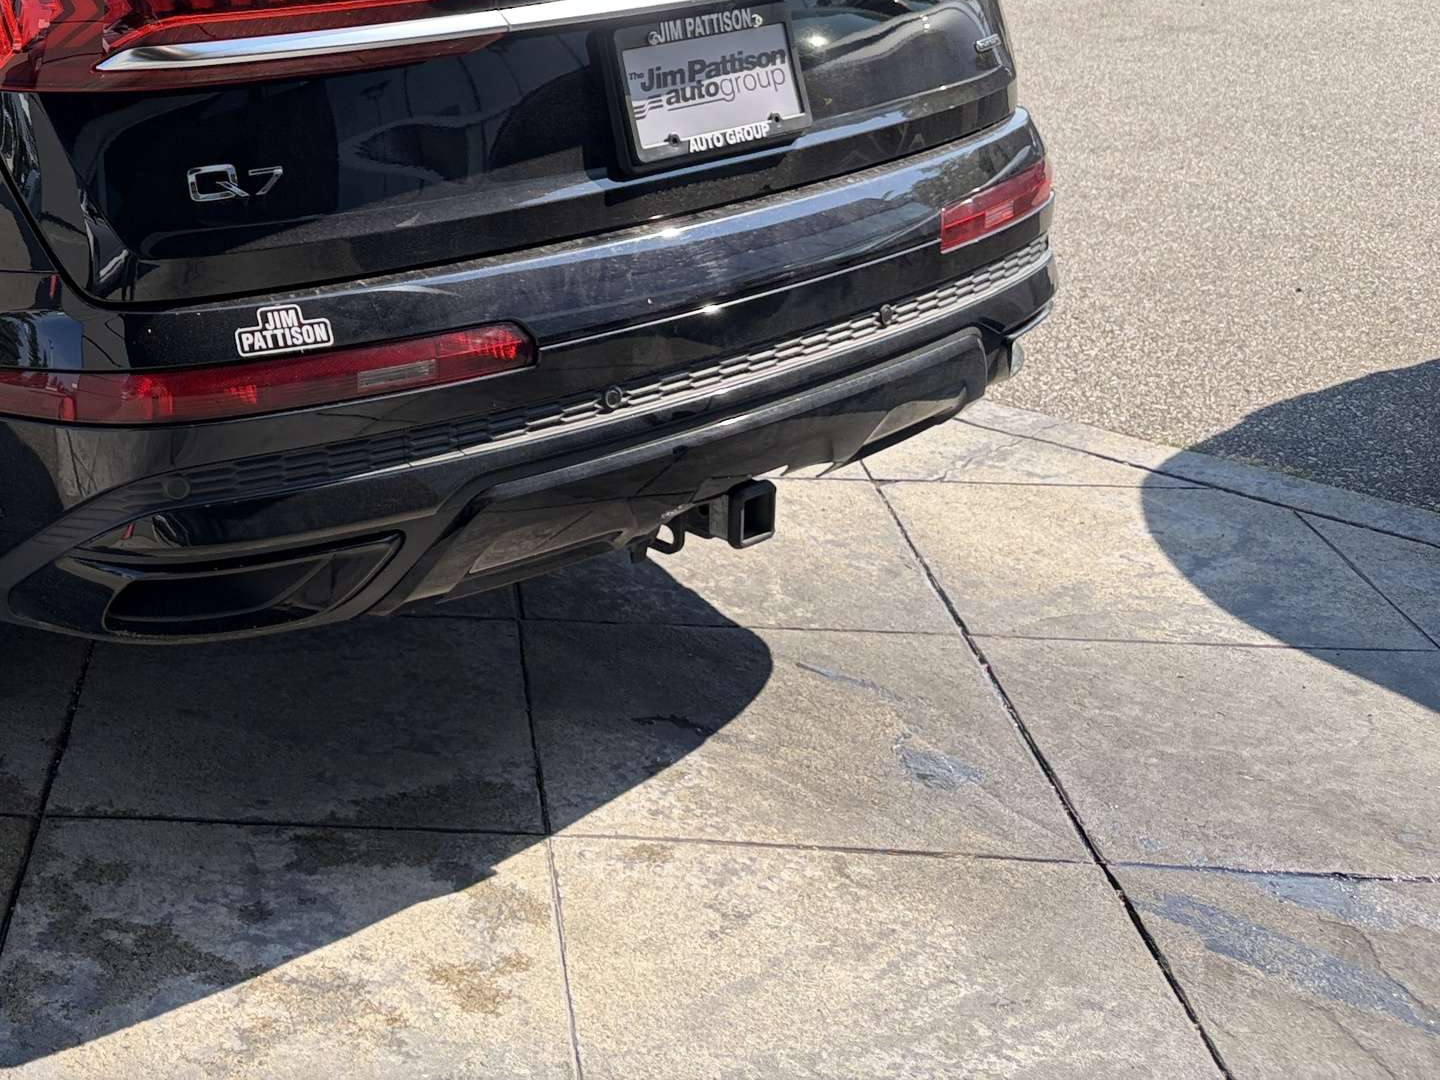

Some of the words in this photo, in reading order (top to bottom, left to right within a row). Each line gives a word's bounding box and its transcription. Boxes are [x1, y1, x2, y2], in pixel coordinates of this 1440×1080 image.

[658, 19, 683, 43] JIM
[685, 7, 753, 39] PATTISON
[628, 70, 645, 81] The
[689, 129, 725, 153] AUTO
[726, 121, 771, 146] GROUP
[187, 164, 283, 202] Q7
[264, 309, 299, 330] JIM
[240, 322, 328, 352] PATTISON
